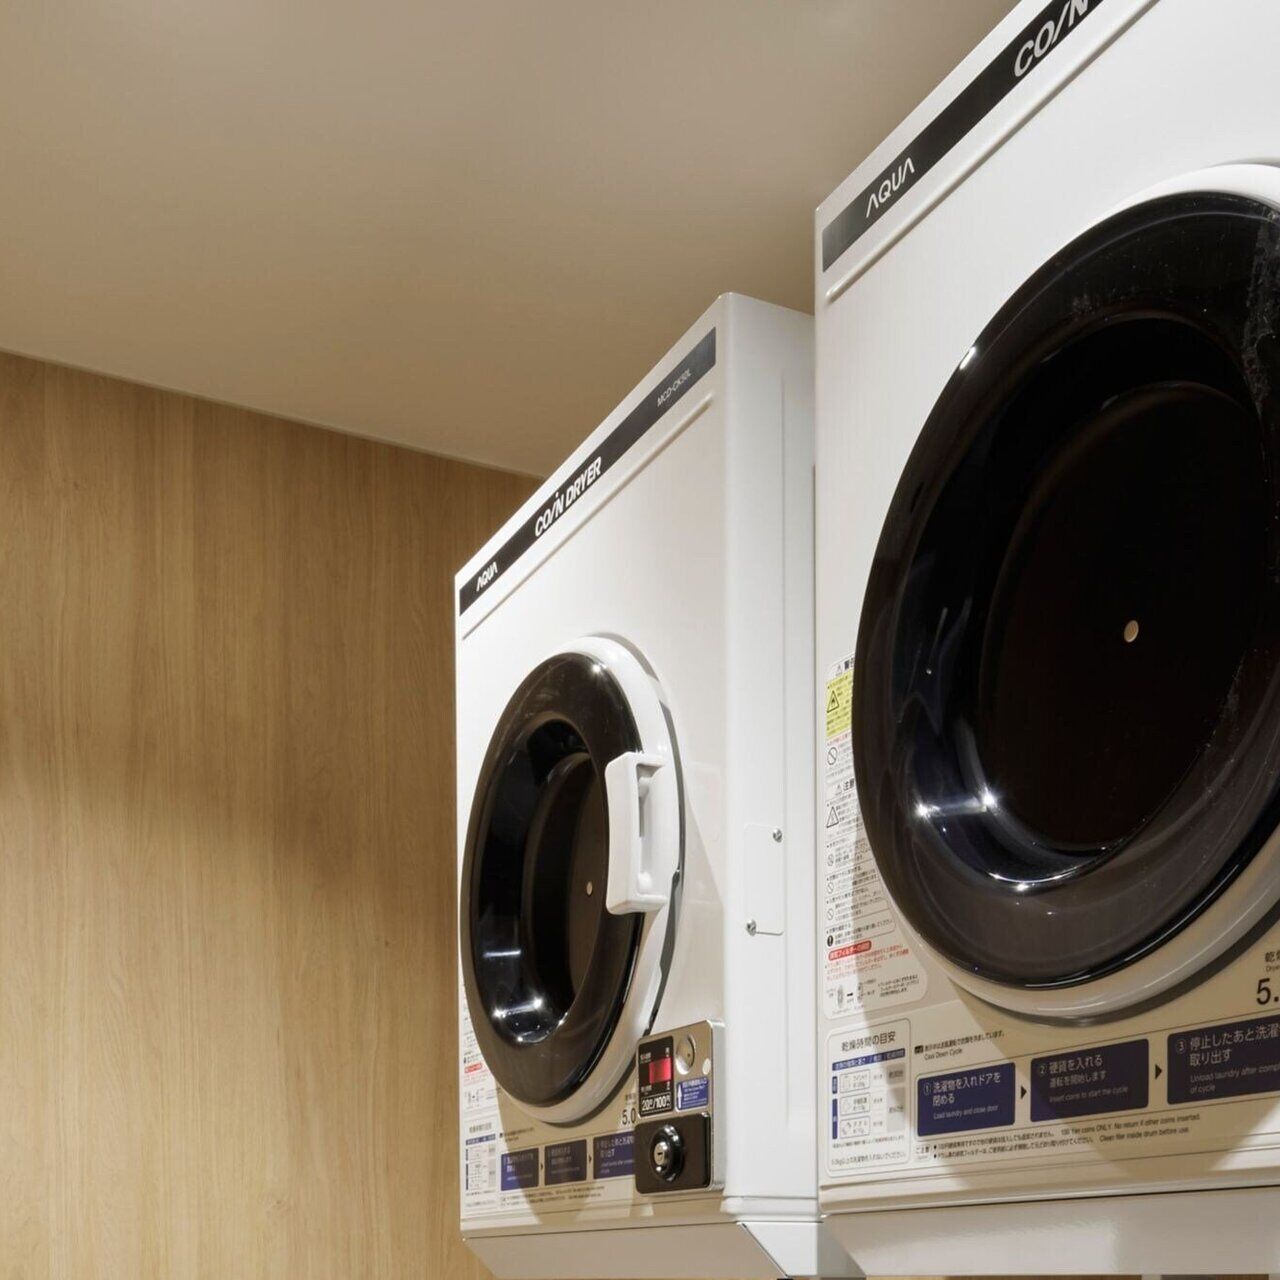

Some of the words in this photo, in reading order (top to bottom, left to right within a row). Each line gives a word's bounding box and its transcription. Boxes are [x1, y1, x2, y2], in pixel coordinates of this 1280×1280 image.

[865, 157, 915, 218] AQUA
[476, 561, 498, 592] AQUA
[565, 456, 602, 508] DRYER
[1189, 1048, 1233, 1068] 取り出す
